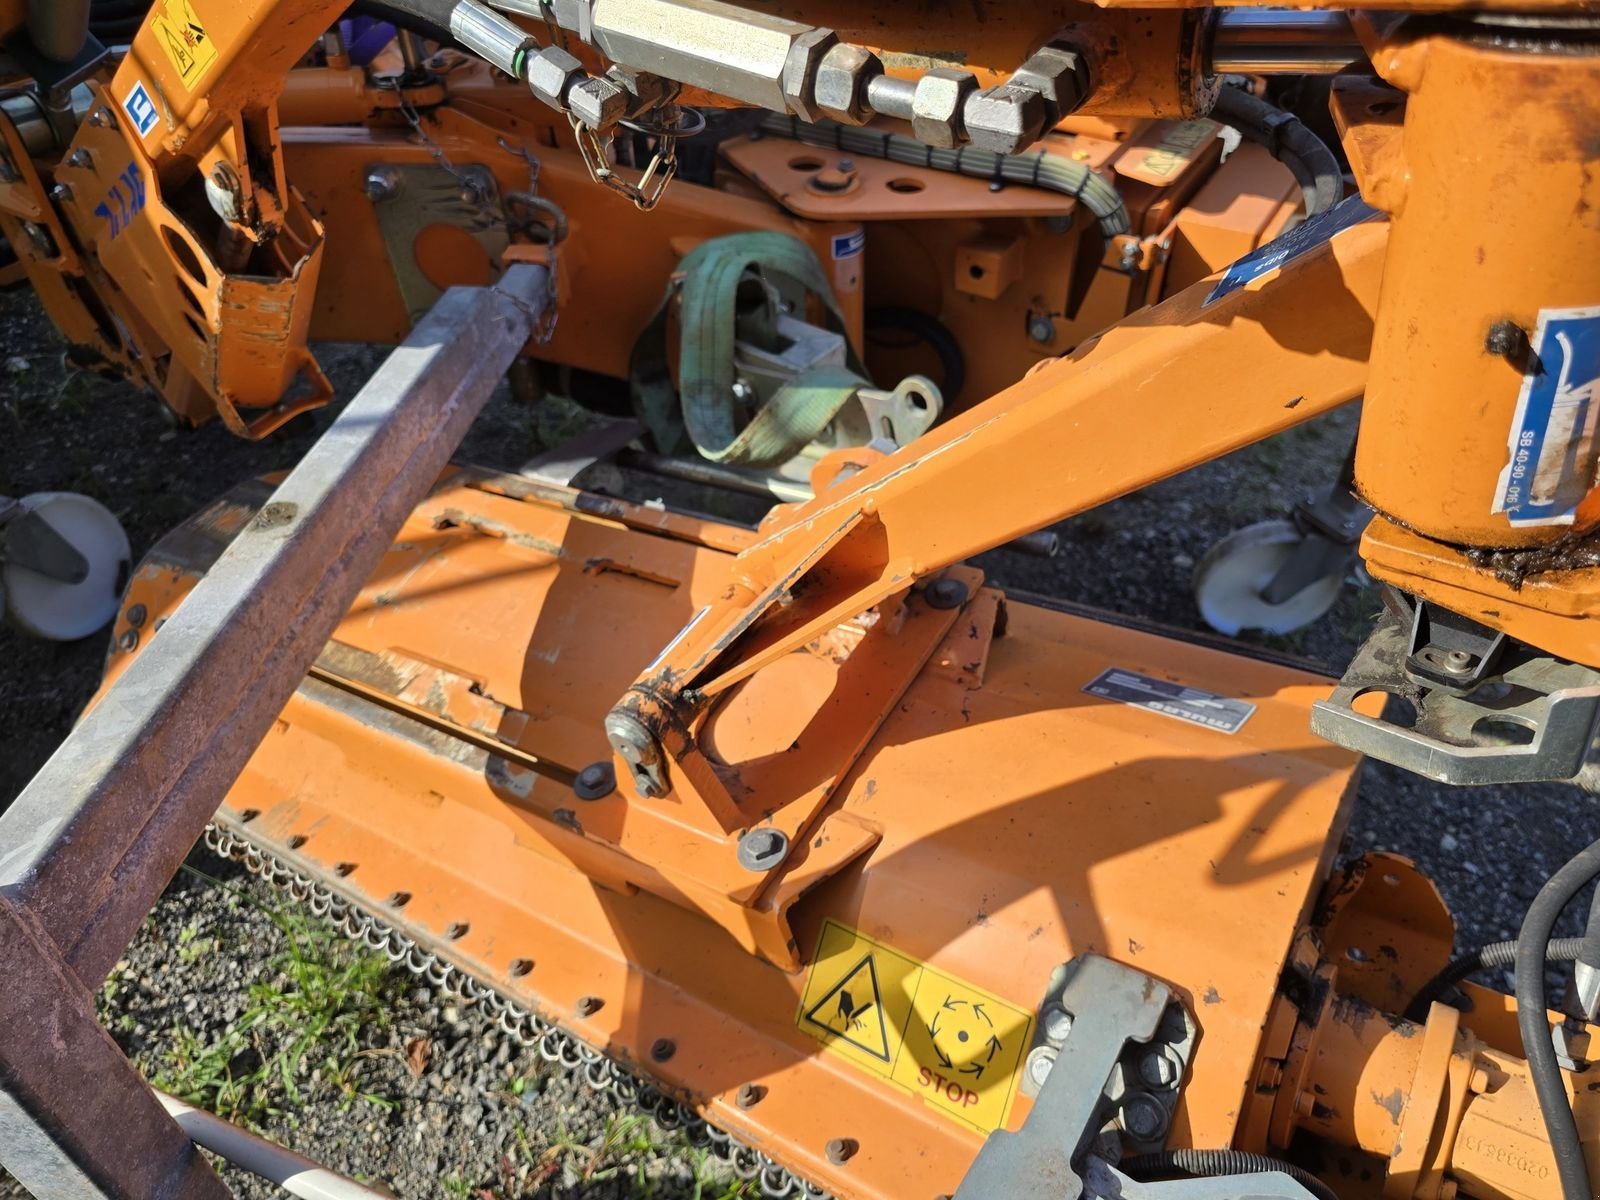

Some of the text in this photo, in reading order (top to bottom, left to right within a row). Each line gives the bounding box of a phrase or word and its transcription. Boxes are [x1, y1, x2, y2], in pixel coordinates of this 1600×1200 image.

[1520, 431, 1534, 447] SB
[1512, 449, 1529, 479] 40-90
[917, 1066, 979, 1108] STOP
